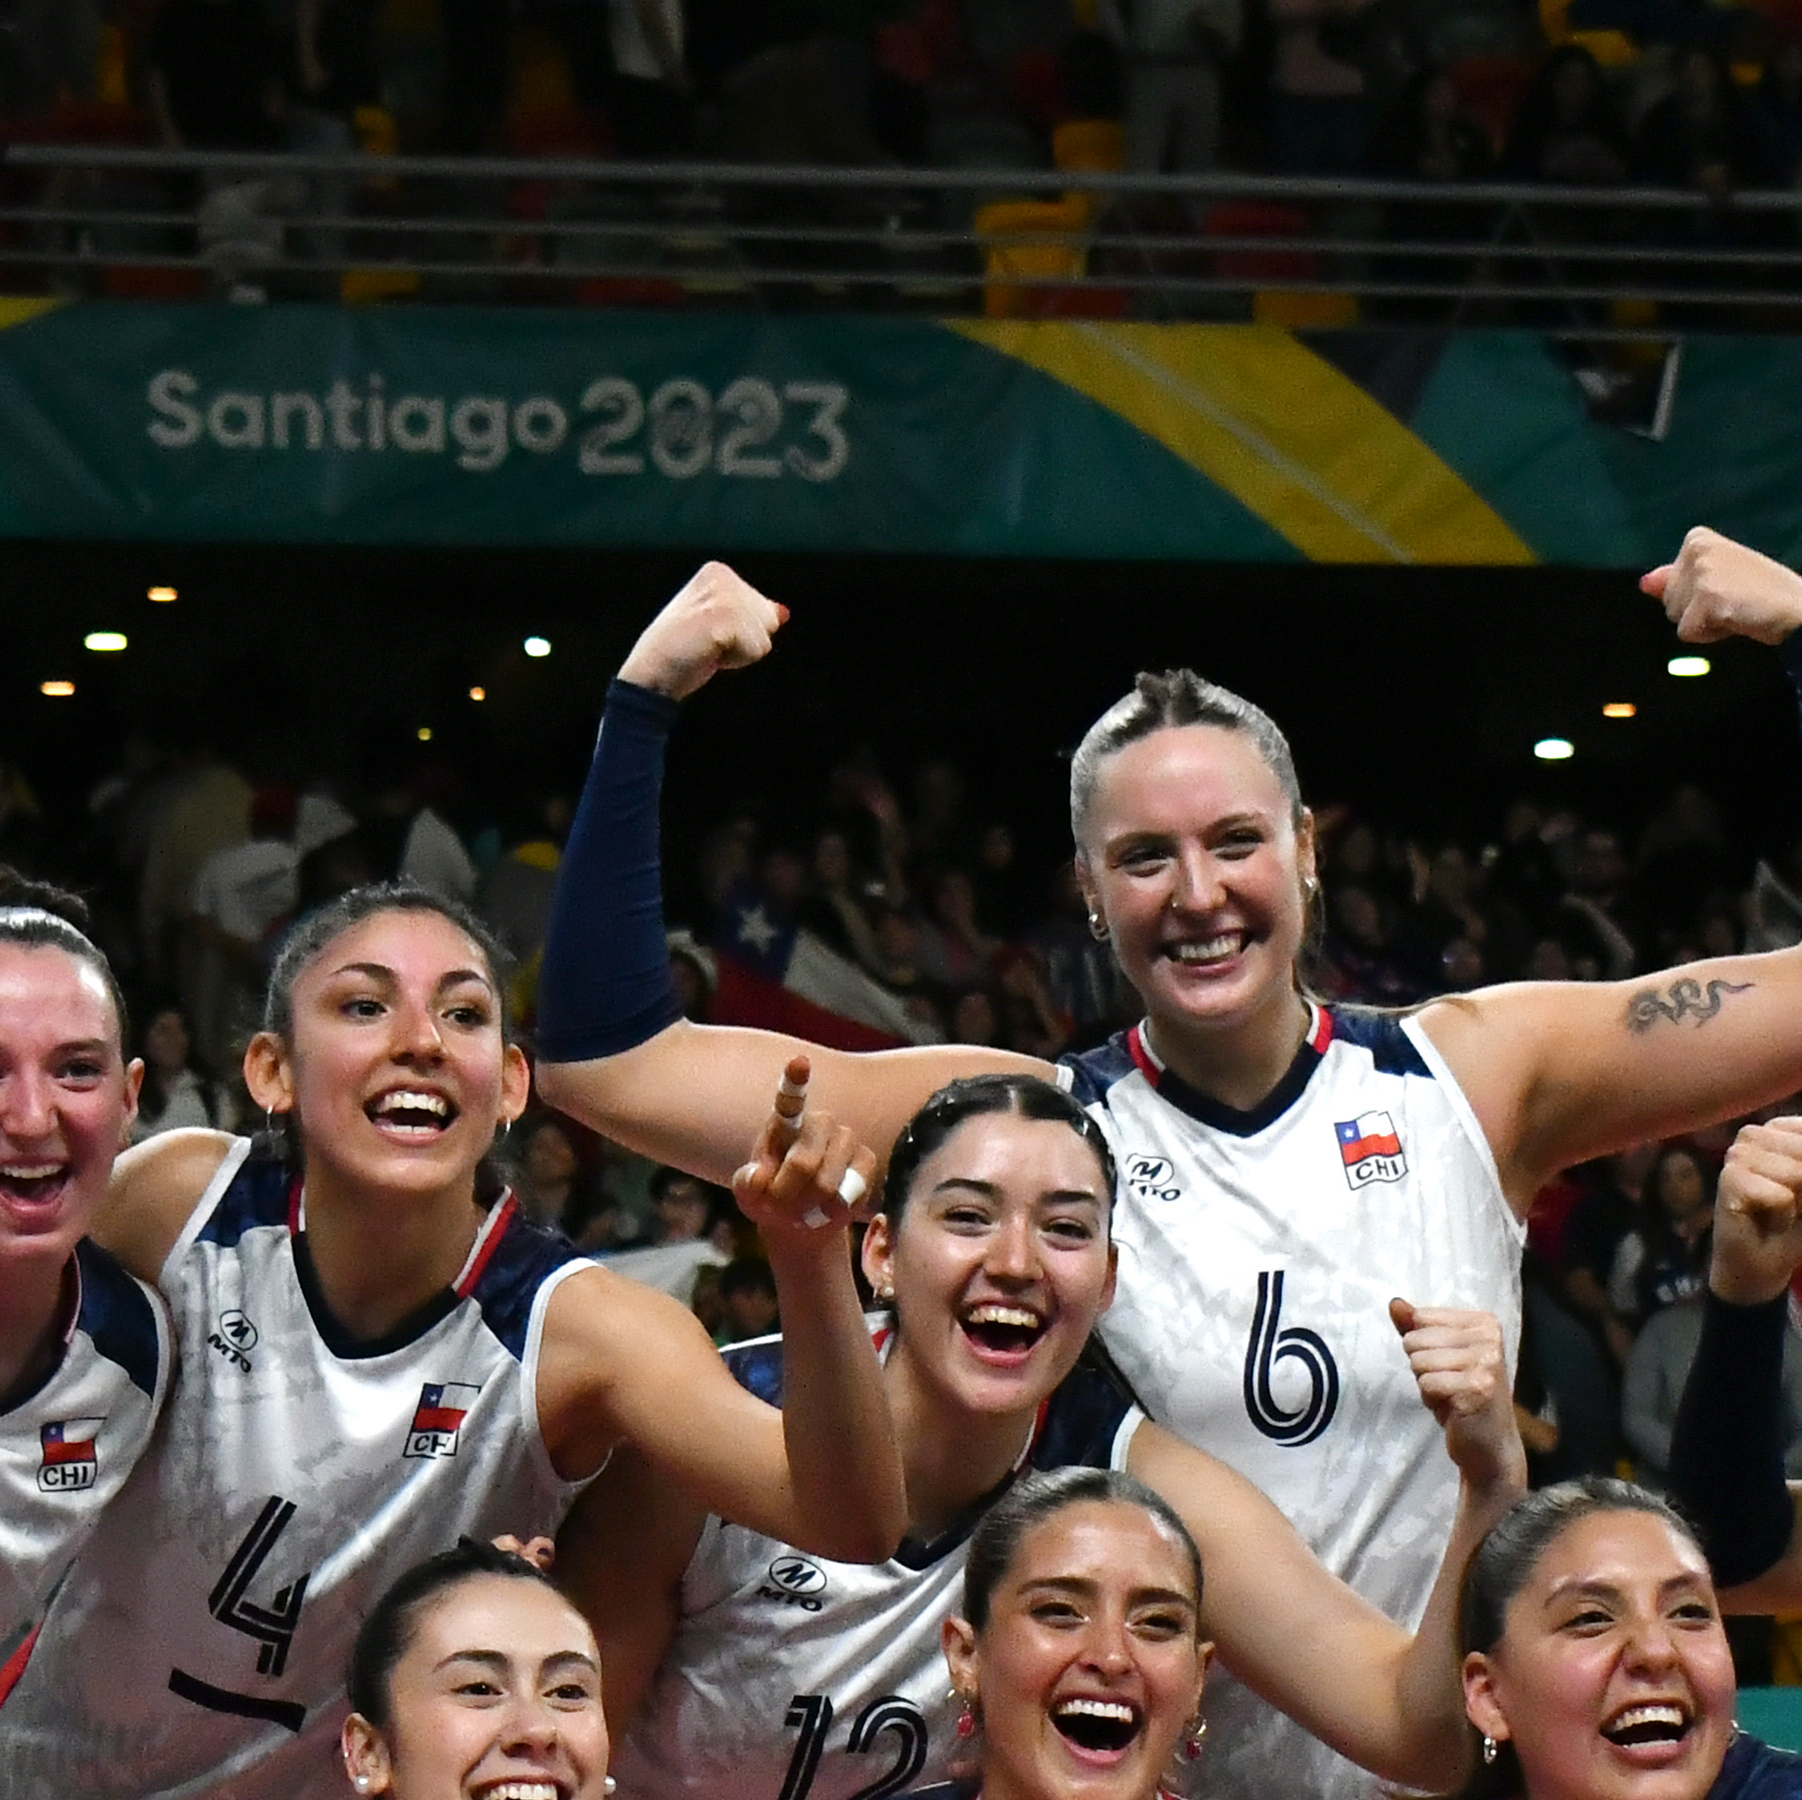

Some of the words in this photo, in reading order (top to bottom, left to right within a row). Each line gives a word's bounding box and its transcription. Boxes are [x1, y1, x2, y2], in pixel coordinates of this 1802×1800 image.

[147, 368, 568, 472] Santiago
[579, 377, 850, 483] 2023
[1356, 1159, 1399, 1180] CHI
[208, 1333, 251, 1373] MTO
[1243, 1270, 1339, 1447] 6
[414, 1434, 450, 1453] CH
[43, 1465, 88, 1486] CHI
[208, 1496, 310, 1676] 4
[755, 1586, 823, 1612] MTO
